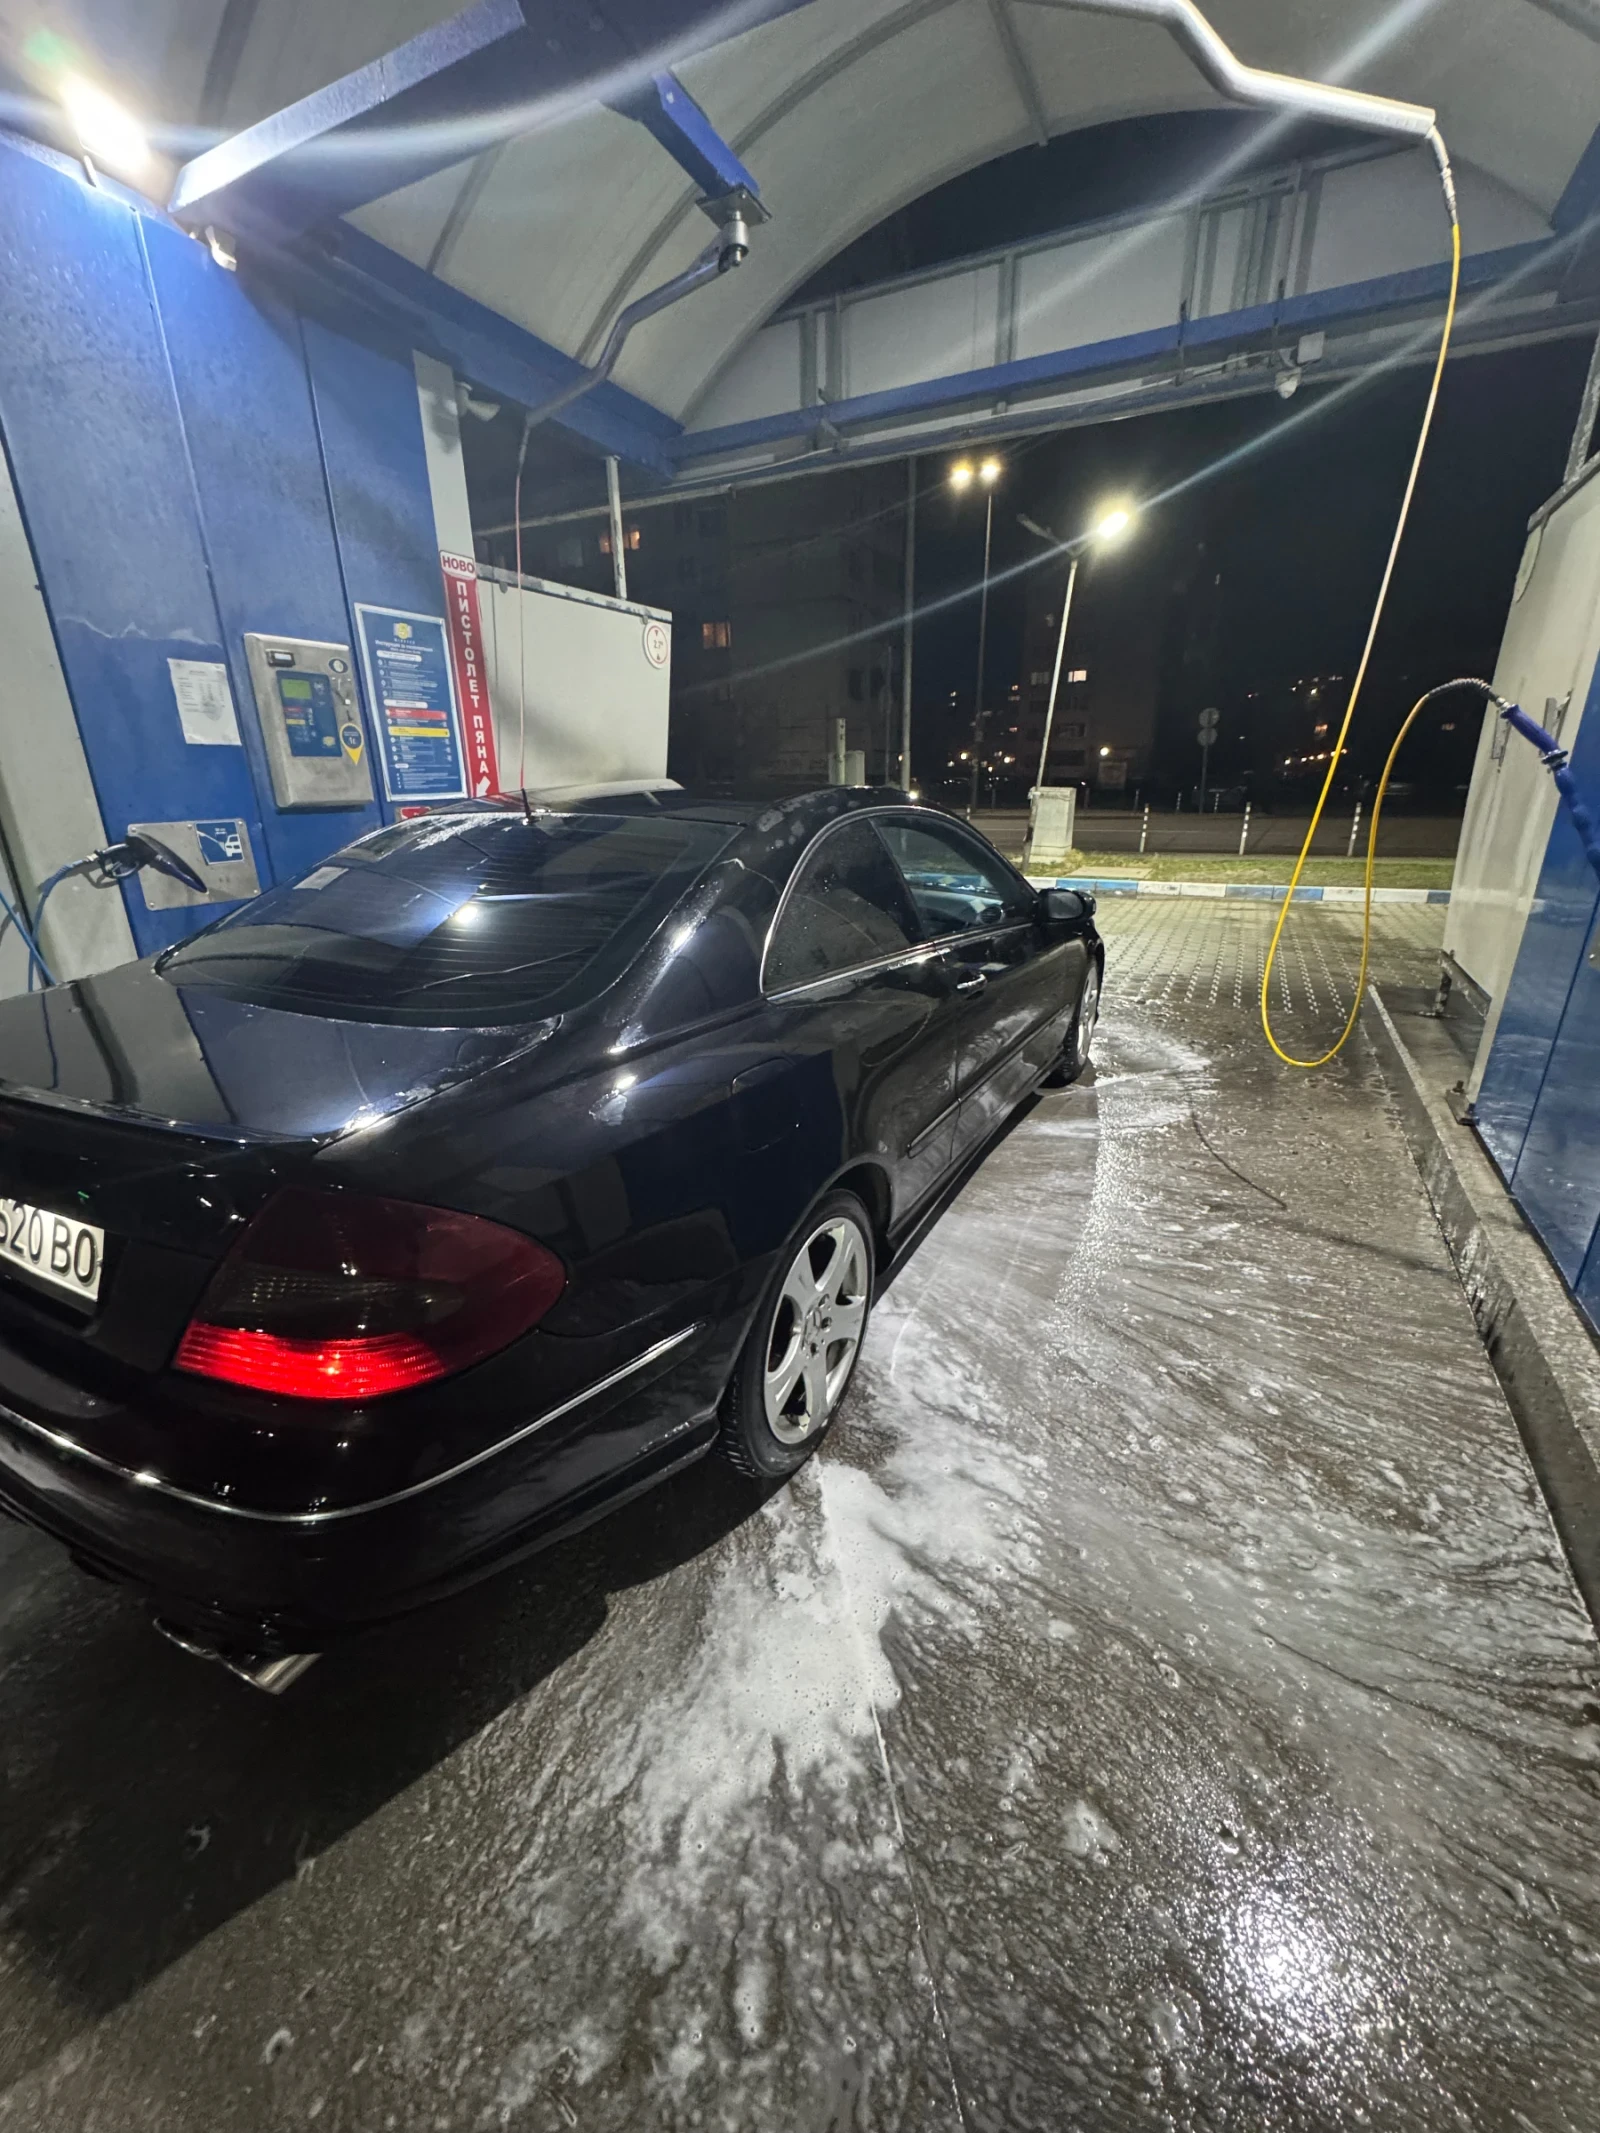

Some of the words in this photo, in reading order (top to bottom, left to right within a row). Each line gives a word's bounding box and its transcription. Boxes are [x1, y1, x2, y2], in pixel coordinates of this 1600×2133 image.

[442, 555, 475, 574] НОВО
[456, 581, 479, 708] ПИСТОЛЕТ
[473, 715, 489, 774] ПЯНА
[51, 1216, 97, 1286] BO
